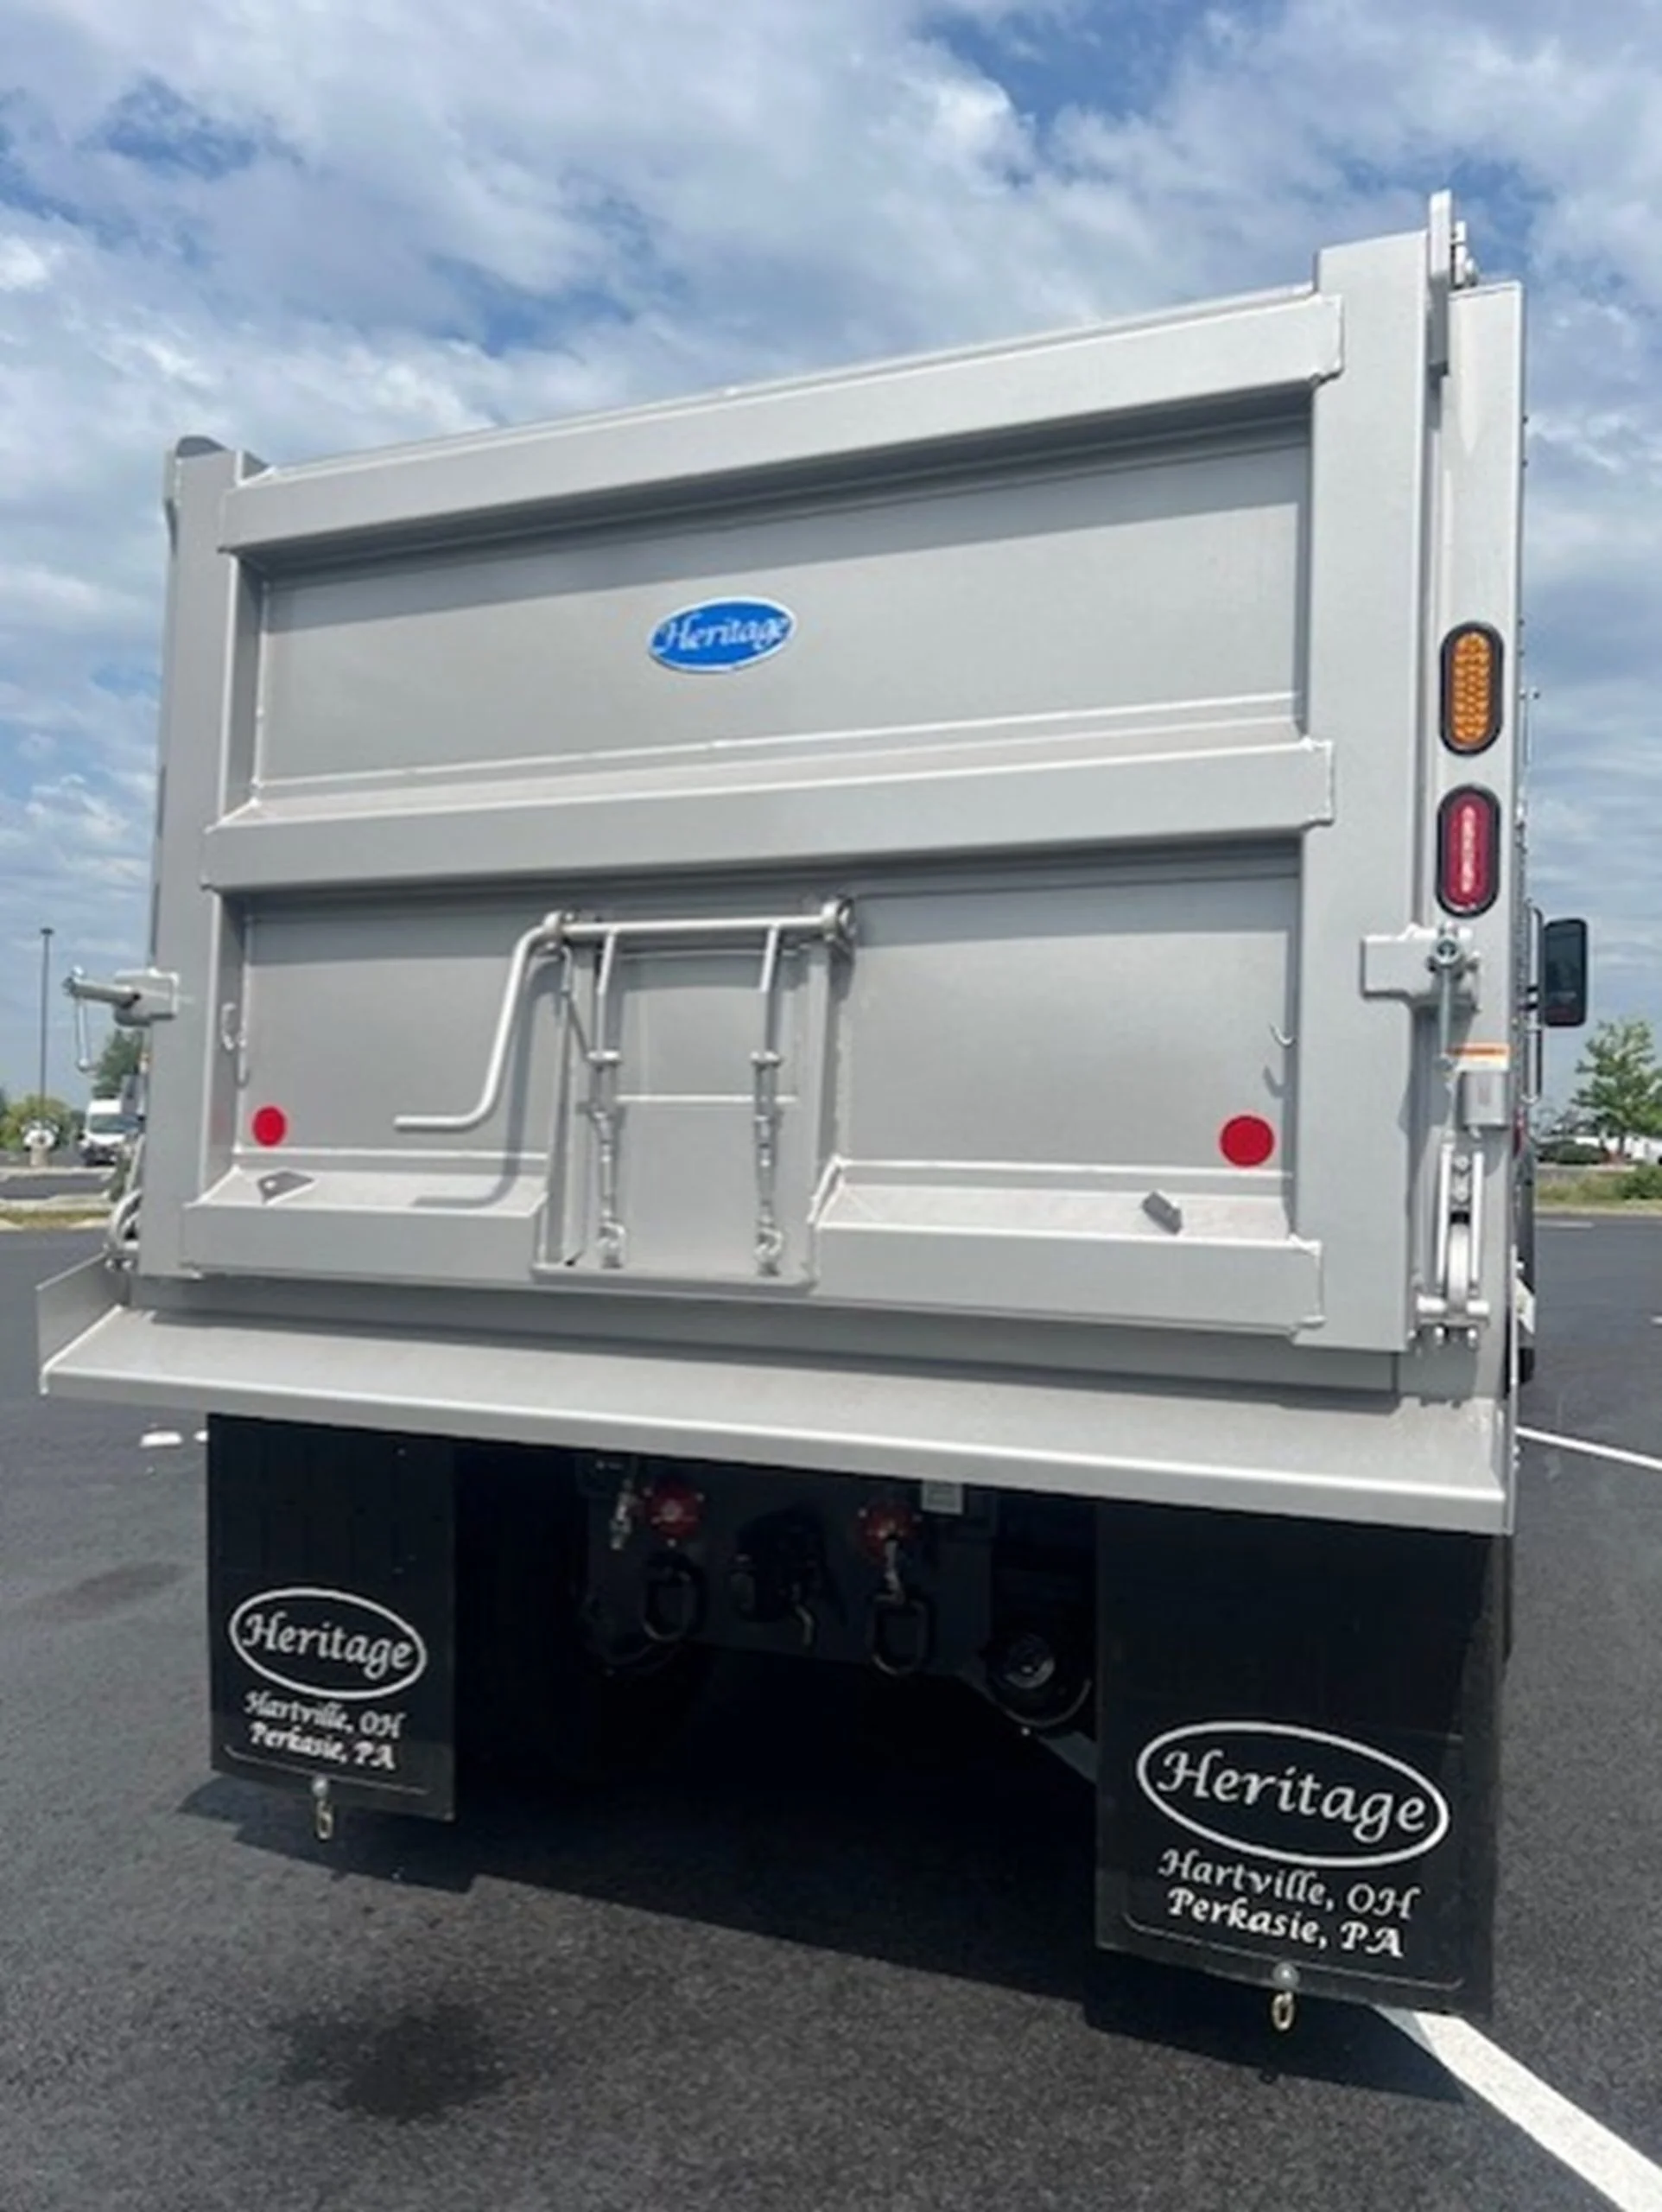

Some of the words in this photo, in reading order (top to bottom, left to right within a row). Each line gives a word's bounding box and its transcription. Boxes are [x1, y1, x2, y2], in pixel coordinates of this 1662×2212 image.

[242, 1611, 413, 1681] Heritage
[244, 1690, 354, 1733] Hartville,
[359, 1711, 407, 1739] OH
[249, 1720, 348, 1763] Perkasie,
[353, 1741, 396, 1770] PA
[1156, 1749, 1427, 1844] Heritage
[1158, 1848, 1335, 1912] Hartville,
[1347, 1883, 1422, 1920] OH
[1167, 1887, 1329, 1950] Perkasie,
[1341, 1921, 1404, 1959] PA
